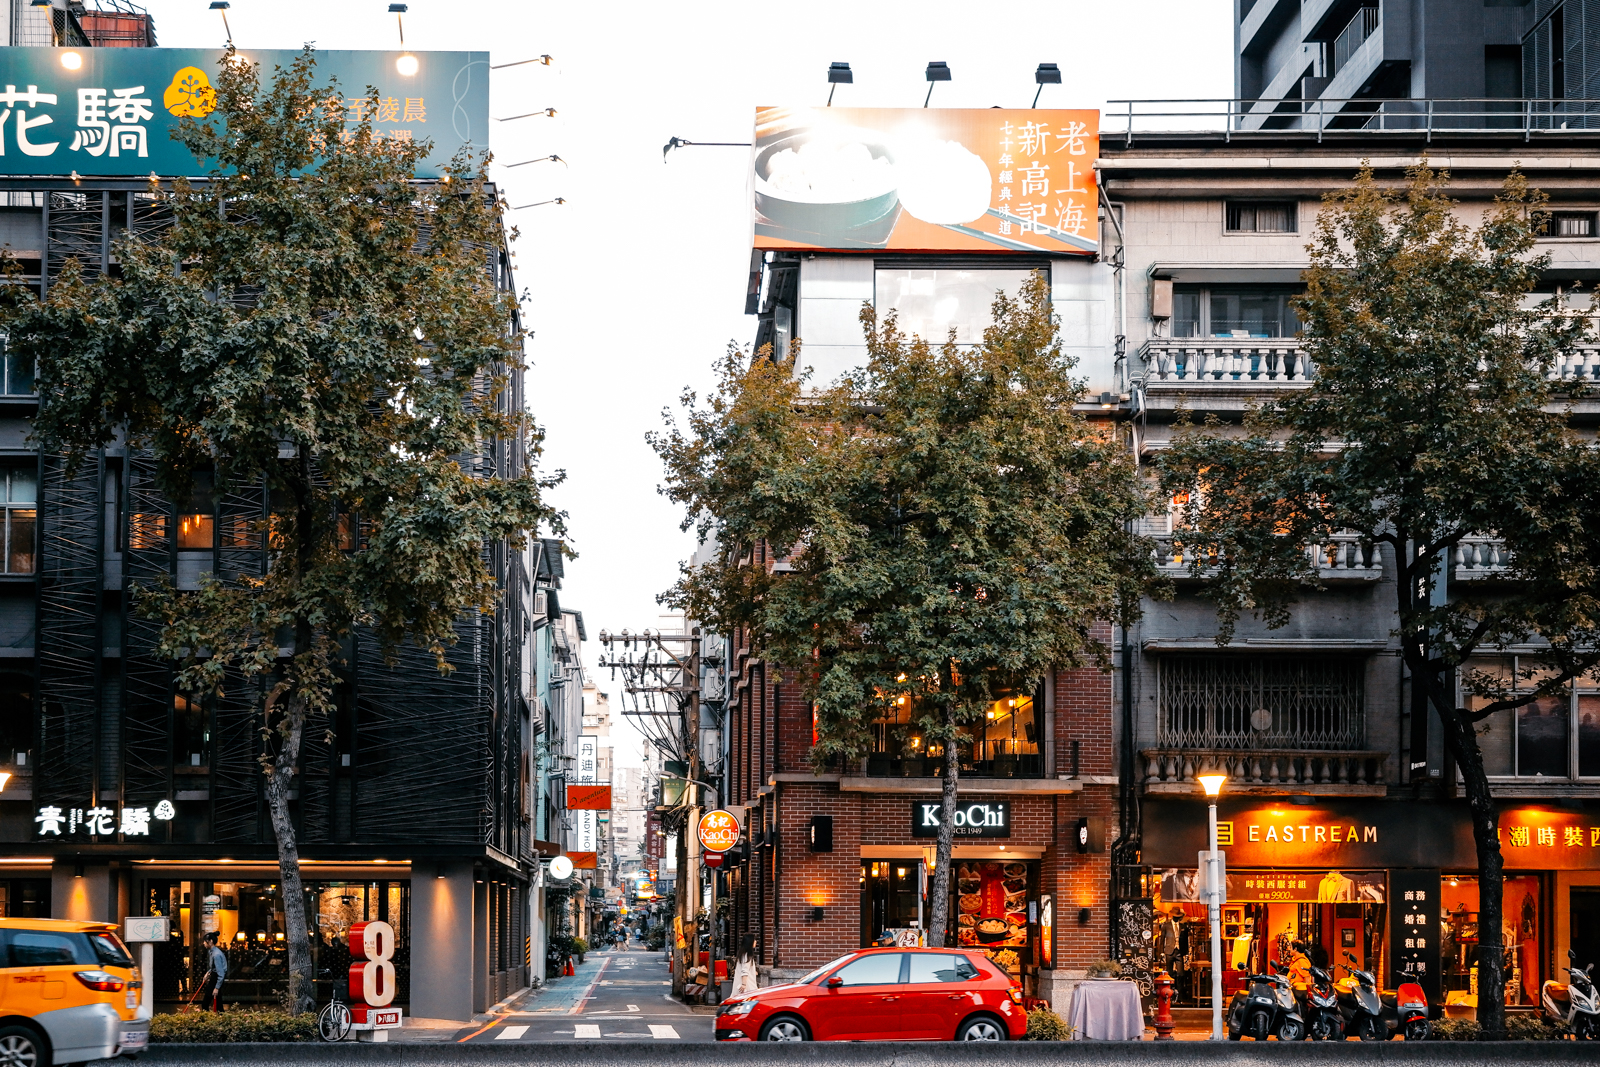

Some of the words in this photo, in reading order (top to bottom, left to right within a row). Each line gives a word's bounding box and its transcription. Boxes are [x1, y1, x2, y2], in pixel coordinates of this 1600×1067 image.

[0, 84, 154, 157] 花驕
[998, 121, 1014, 235] 七十年經典味道
[1016, 121, 1051, 236] 新高記
[1054, 121, 1090, 236] 老上海
[921, 804, 1004, 827] KoChi
[700, 828, 738, 840] KaoChi
[1249, 825, 1378, 843] EASTREAM
[1497, 826, 1600, 847] 潮時裝西
[1404, 891, 1426, 901] 商務
[1404, 914, 1426, 925] 婚禮
[1405, 938, 1426, 949] 租借
[362, 920, 396, 1007] 8
